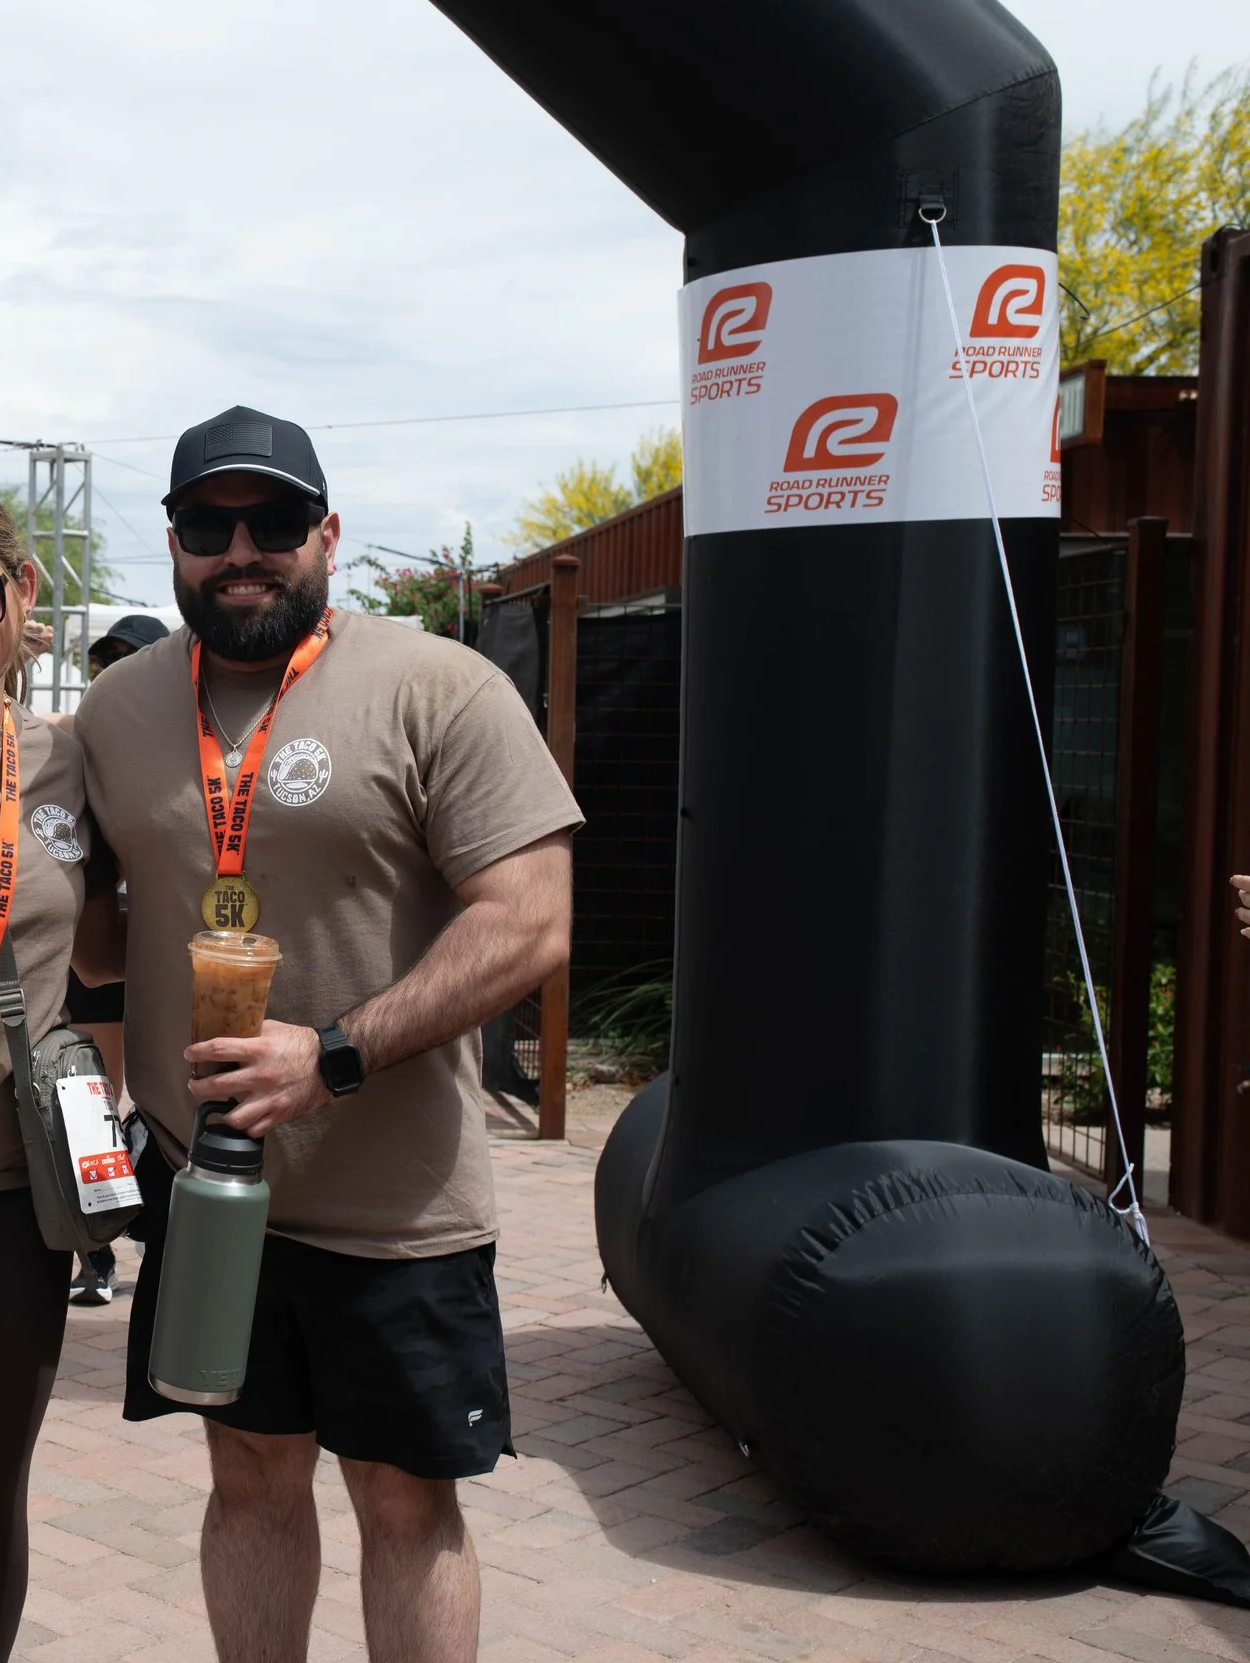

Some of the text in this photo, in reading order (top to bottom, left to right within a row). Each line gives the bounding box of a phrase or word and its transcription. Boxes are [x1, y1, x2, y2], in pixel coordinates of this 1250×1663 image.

[954, 346, 1043, 358] ROAD RUNNER
[691, 361, 767, 385] ROAD RUNNER
[948, 360, 1041, 379] SPORTS
[690, 375, 764, 405] SPORTS
[769, 474, 890, 492] ROAD RUNNER
[764, 488, 887, 514] SPORTS
[275, 745, 293, 763] THE
[293, 740, 317, 752] TACO
[5, 732, 16, 802] THE TACO 5K
[207, 776, 222, 794] 5K
[308, 784, 322, 799] AZ
[34, 809, 47, 824] THE
[44, 806, 66, 819] TACO
[210, 794, 227, 829] TACO
[226, 772, 254, 853] THE TACO 5K
[1, 840, 15, 857] 5K
[214, 890, 246, 904] TACO
[215, 903, 246, 928] 5K
[86, 1081, 101, 1096] THE
